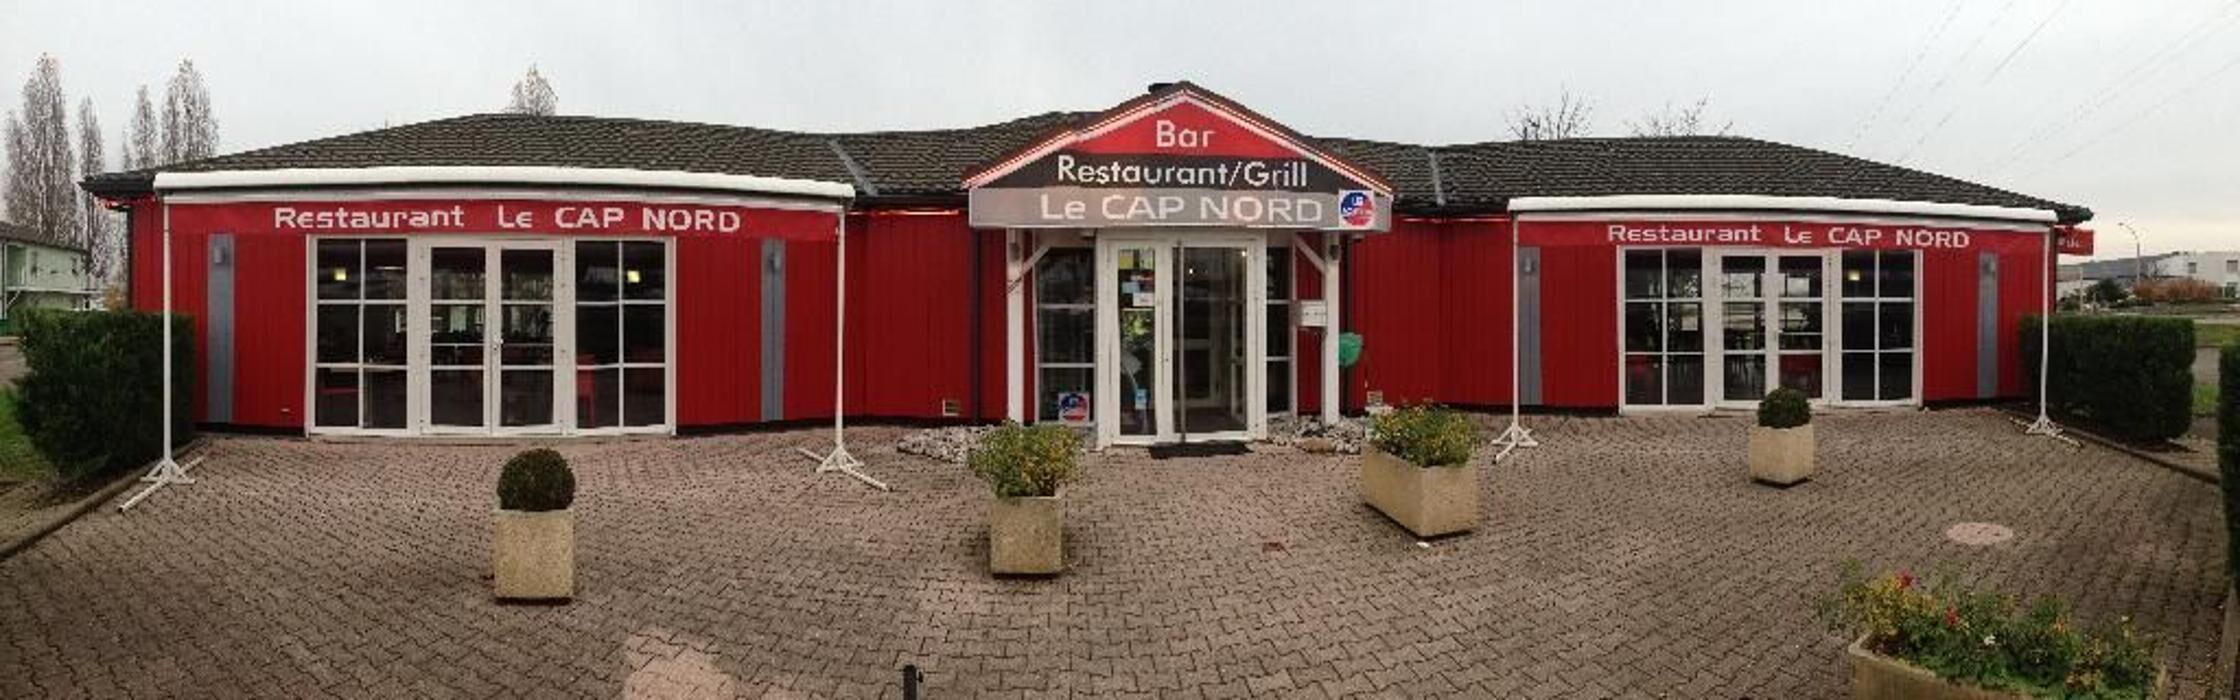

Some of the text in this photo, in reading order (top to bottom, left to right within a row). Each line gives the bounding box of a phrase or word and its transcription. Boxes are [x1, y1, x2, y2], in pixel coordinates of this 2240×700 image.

[1156, 120, 1215, 148] Bar
[1058, 155, 1307, 188] Restaurant/Grill
[275, 205, 741, 233] Restaurant Le CAP NORD
[1041, 194, 1086, 220] Le
[1102, 195, 1184, 220] CAP
[1199, 196, 1322, 223] NORD
[1608, 224, 1970, 248] Restaurant Le CAP NORD
